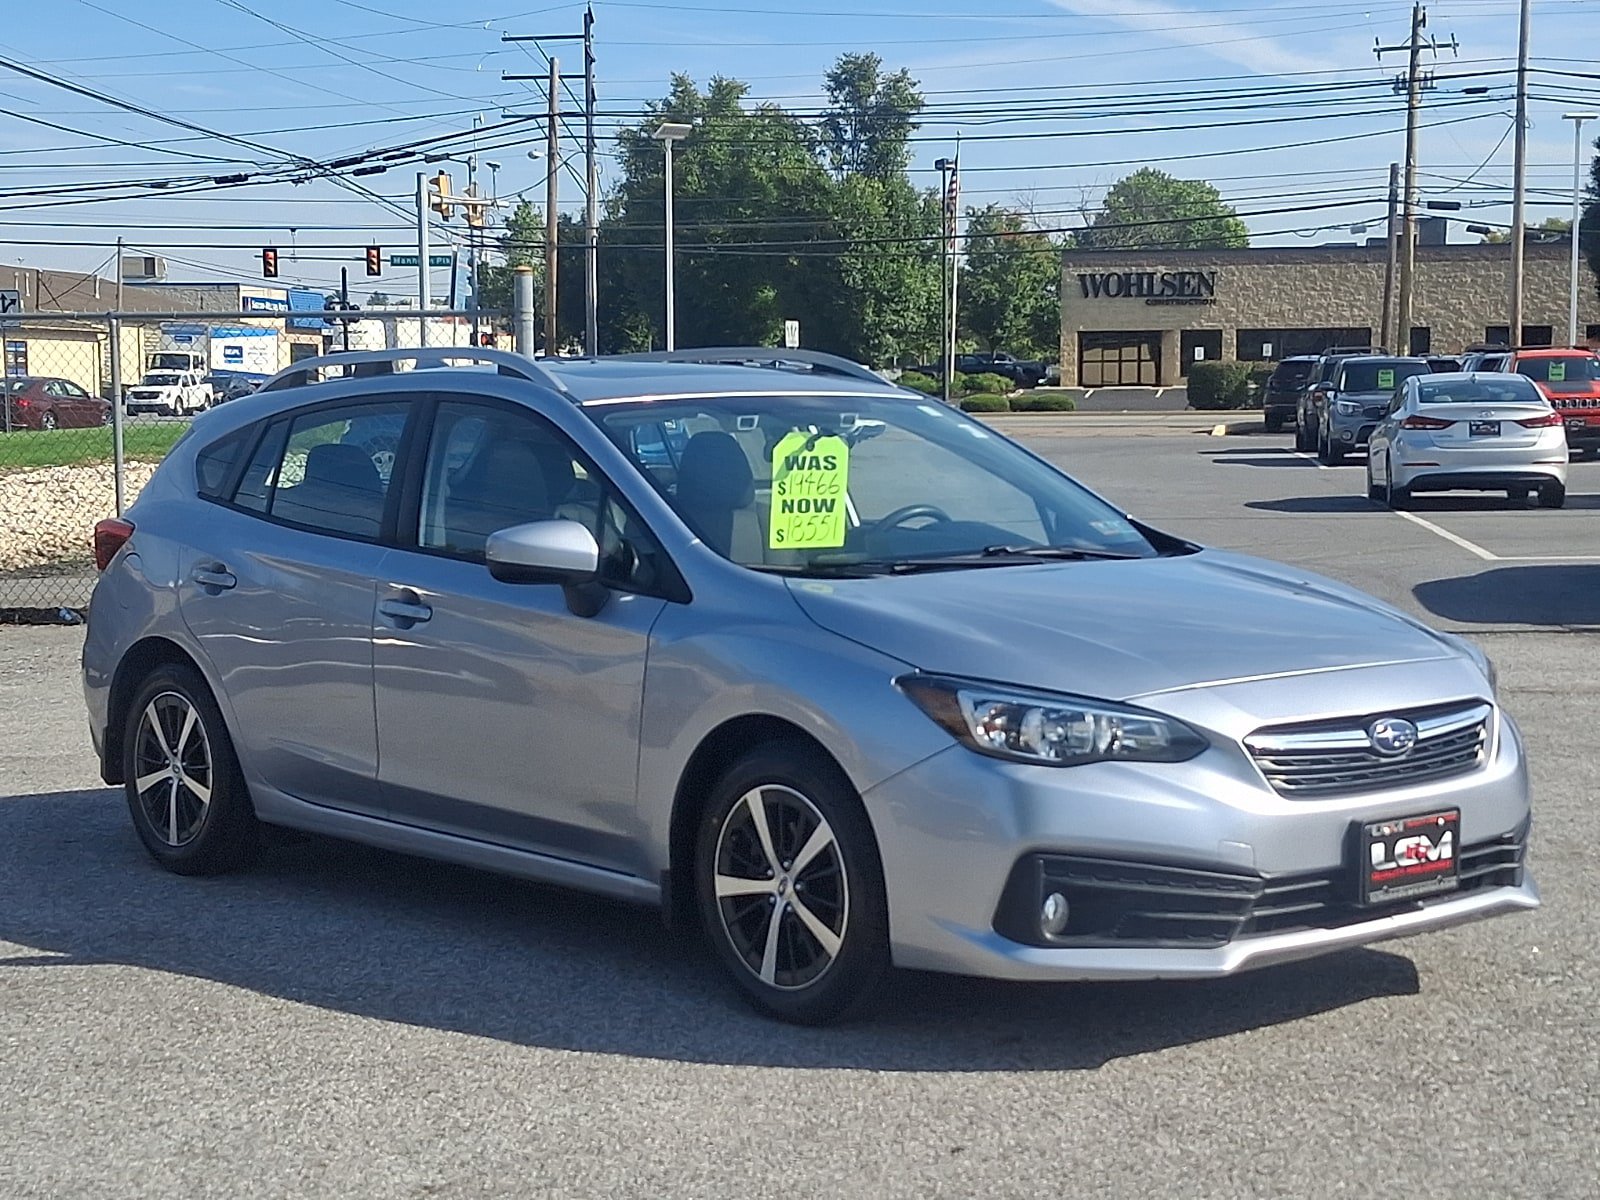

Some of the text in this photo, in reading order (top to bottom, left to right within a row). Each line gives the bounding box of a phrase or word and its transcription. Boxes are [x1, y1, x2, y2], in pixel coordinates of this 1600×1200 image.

[1077, 271, 1217, 298] WOHLSEN
[784, 455, 837, 471] WAS
[781, 498, 836, 514] NOW
